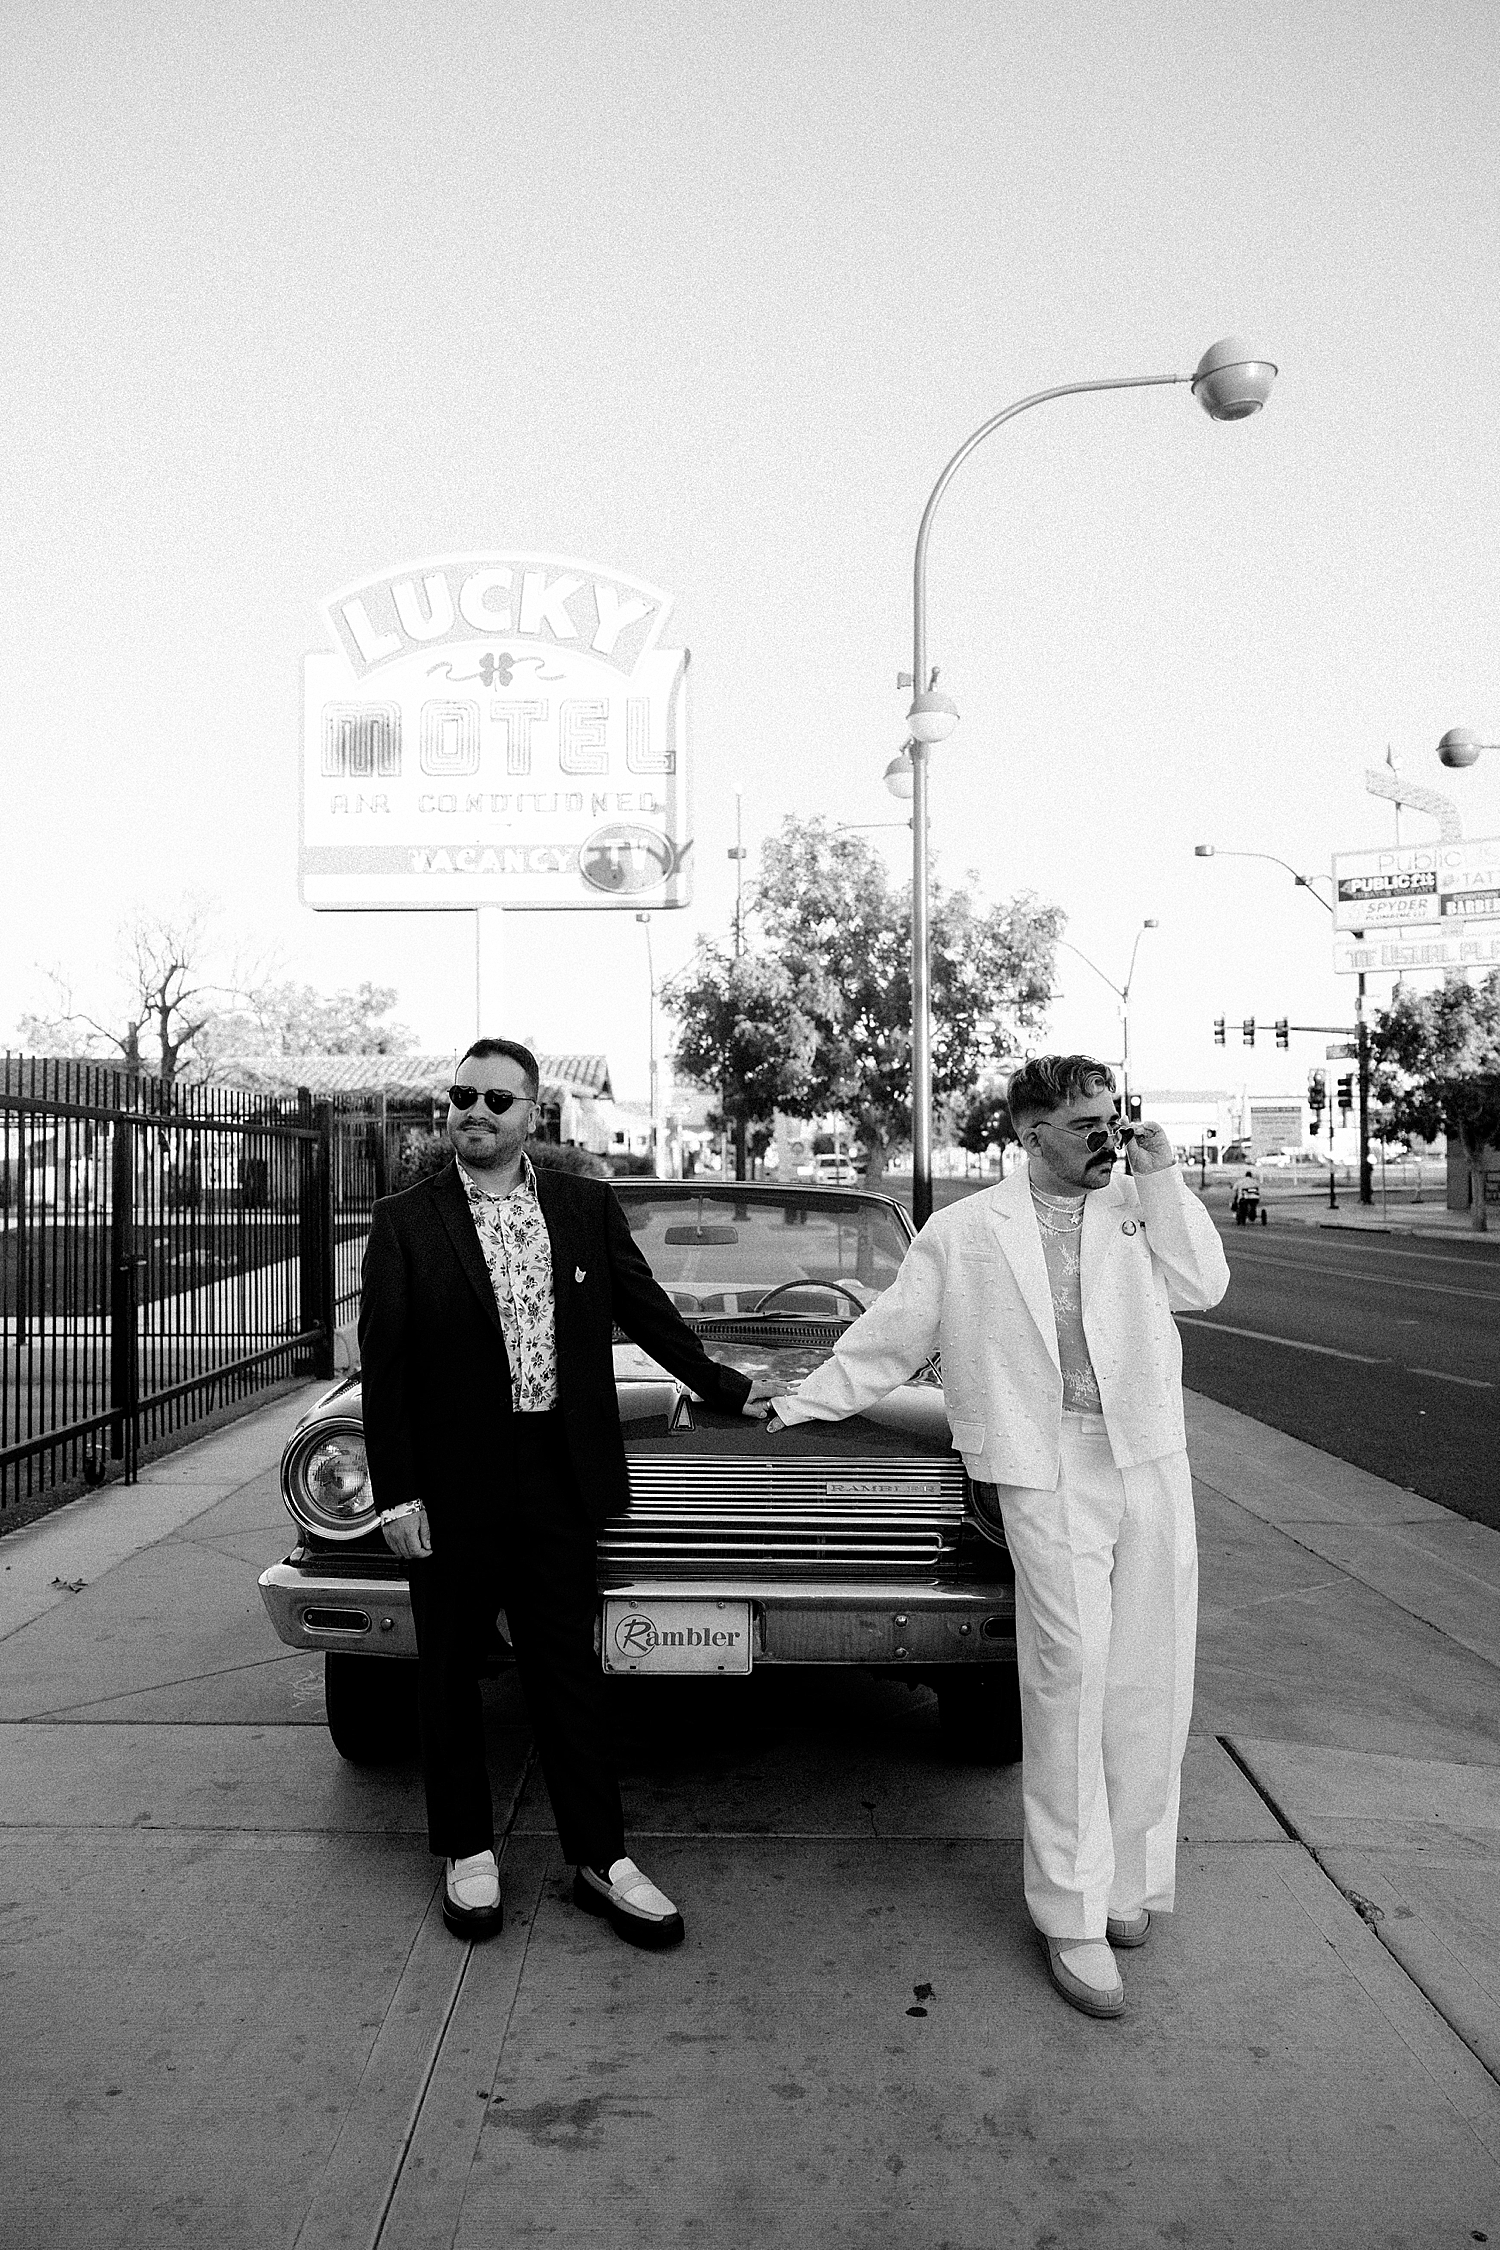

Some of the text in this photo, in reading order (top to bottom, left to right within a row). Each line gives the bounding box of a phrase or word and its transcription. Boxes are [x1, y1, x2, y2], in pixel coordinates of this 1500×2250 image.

[340, 565, 656, 664] LUCKY
[320, 697, 676, 778] MOTEL
[331, 792, 391, 815] AIR
[418, 792, 658, 815] CONDITIONED
[409, 848, 575, 874] VACANCY
[604, 838, 649, 871] TV
[1462, 870, 1500, 887] TAT
[1366, 898, 1429, 914] SPYDER
[831, 1484, 936, 1493] RAMBLER
[622, 1618, 741, 1654] Rambler
